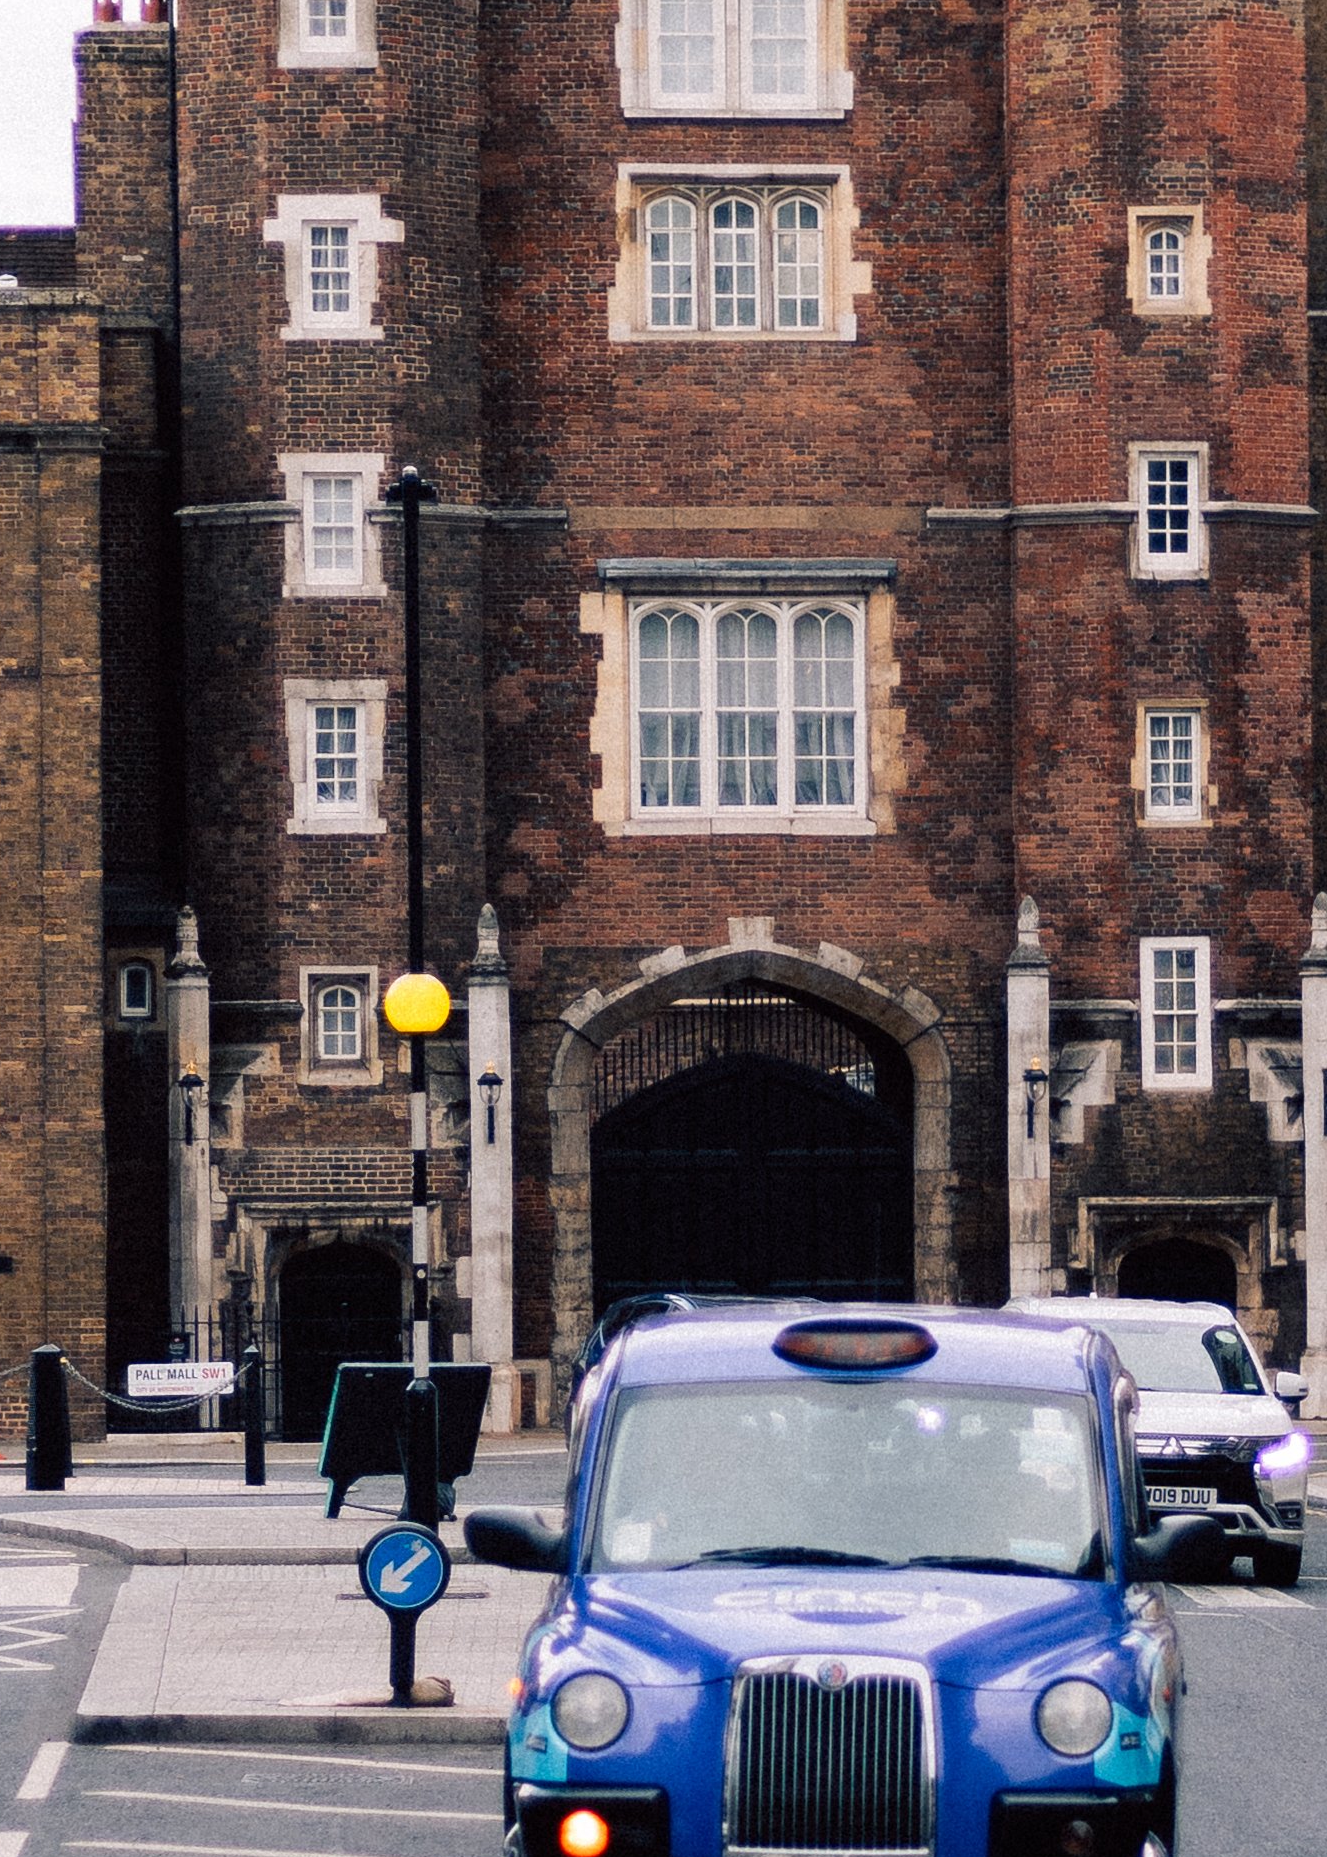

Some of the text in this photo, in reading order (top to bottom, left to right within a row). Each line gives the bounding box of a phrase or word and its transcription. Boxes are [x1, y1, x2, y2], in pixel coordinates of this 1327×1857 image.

[136, 1367, 226, 1380] PALL MALL SW1
[1180, 1488, 1211, 1505] DUU
